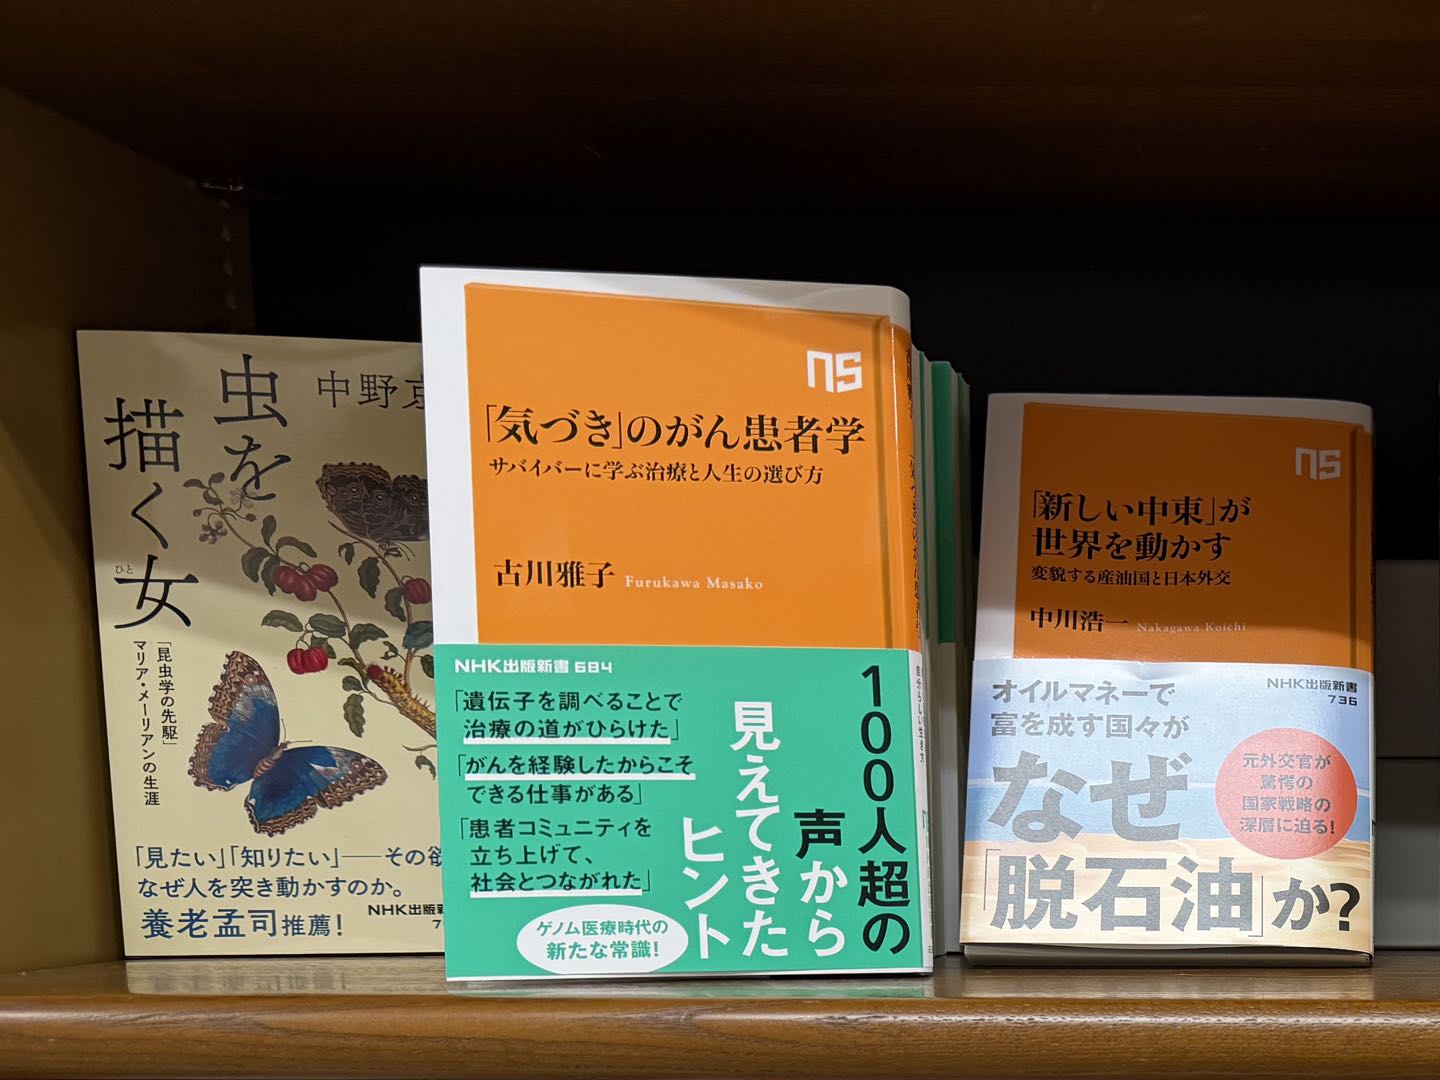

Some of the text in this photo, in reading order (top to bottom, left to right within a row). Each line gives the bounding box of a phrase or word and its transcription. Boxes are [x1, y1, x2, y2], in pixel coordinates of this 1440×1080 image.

[214, 353, 290, 500] 虫を
[486, 404, 866, 455] 「気づき」のがん患者学
[489, 458, 823, 485] サバイバーに学ぶ治療と人生の選び方
[104, 397, 199, 629] 描く女
[1033, 490, 1250, 526] 「新しい中東」が
[1032, 527, 1232, 562] 世界を動かす
[493, 559, 615, 589] 古川雅子
[625, 575, 763, 590] Furukawa Masako
[1031, 566, 1232, 587] 変貌する産油国と日本外交
[1030, 608, 1128, 632] 中川浩一
[1137, 622, 1246, 634] Nakagawa Koichi
[455, 659, 612, 674] NHK出版新書 684
[993, 679, 1175, 706] オイルマネーで
[1267, 677, 1357, 694] NHK出版新書
[455, 690, 682, 712] 「遺伝子を調べることで
[1328, 695, 1357, 706] 736
[464, 718, 679, 741] 治療の道がひらけた」
[991, 713, 1189, 739] 富を成す国々が
[458, 754, 694, 776] 「がんを経験したからこそ
[1243, 753, 1331, 770] 元外交官が
[467, 783, 642, 805] できる仕事がある」
[989, 751, 1193, 843] なぜ
[1243, 796, 1331, 813] 国家戦略の
[858, 665, 911, 955] 100人超の
[460, 817, 651, 839] 「患者コミュニティを
[731, 701, 788, 957] 見えてきた
[470, 844, 594, 865] 立ち上げて、
[138, 877, 403, 899] なぜ人を突き動かすのか。
[470, 871, 651, 892] 社会とつながれた」
[682, 817, 730, 959] ヒント
[794, 809, 847, 957] 声から
[536, 919, 668, 937] ゲノム医療時代の
